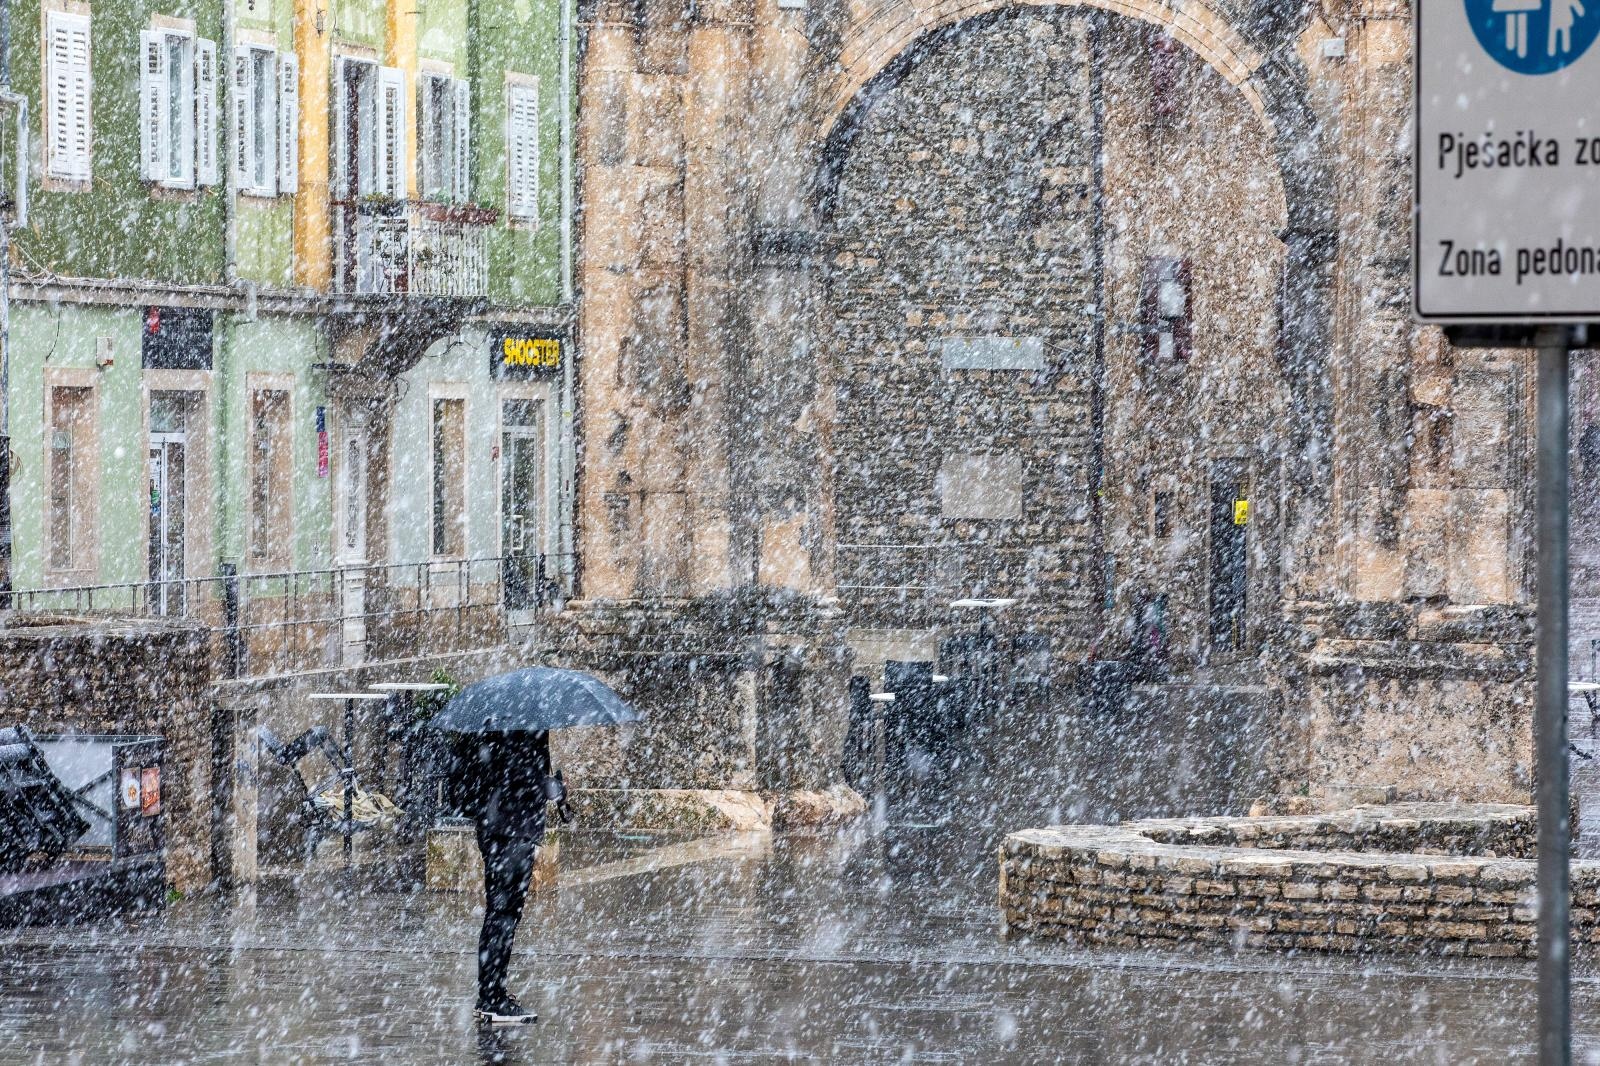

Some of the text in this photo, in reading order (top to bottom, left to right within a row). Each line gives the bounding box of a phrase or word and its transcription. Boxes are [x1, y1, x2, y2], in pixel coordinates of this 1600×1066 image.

[1439, 130, 1559, 178] Pješačka
[1439, 238, 1600, 285] Zona pedon
[504, 338, 559, 366] SHOOSTER
